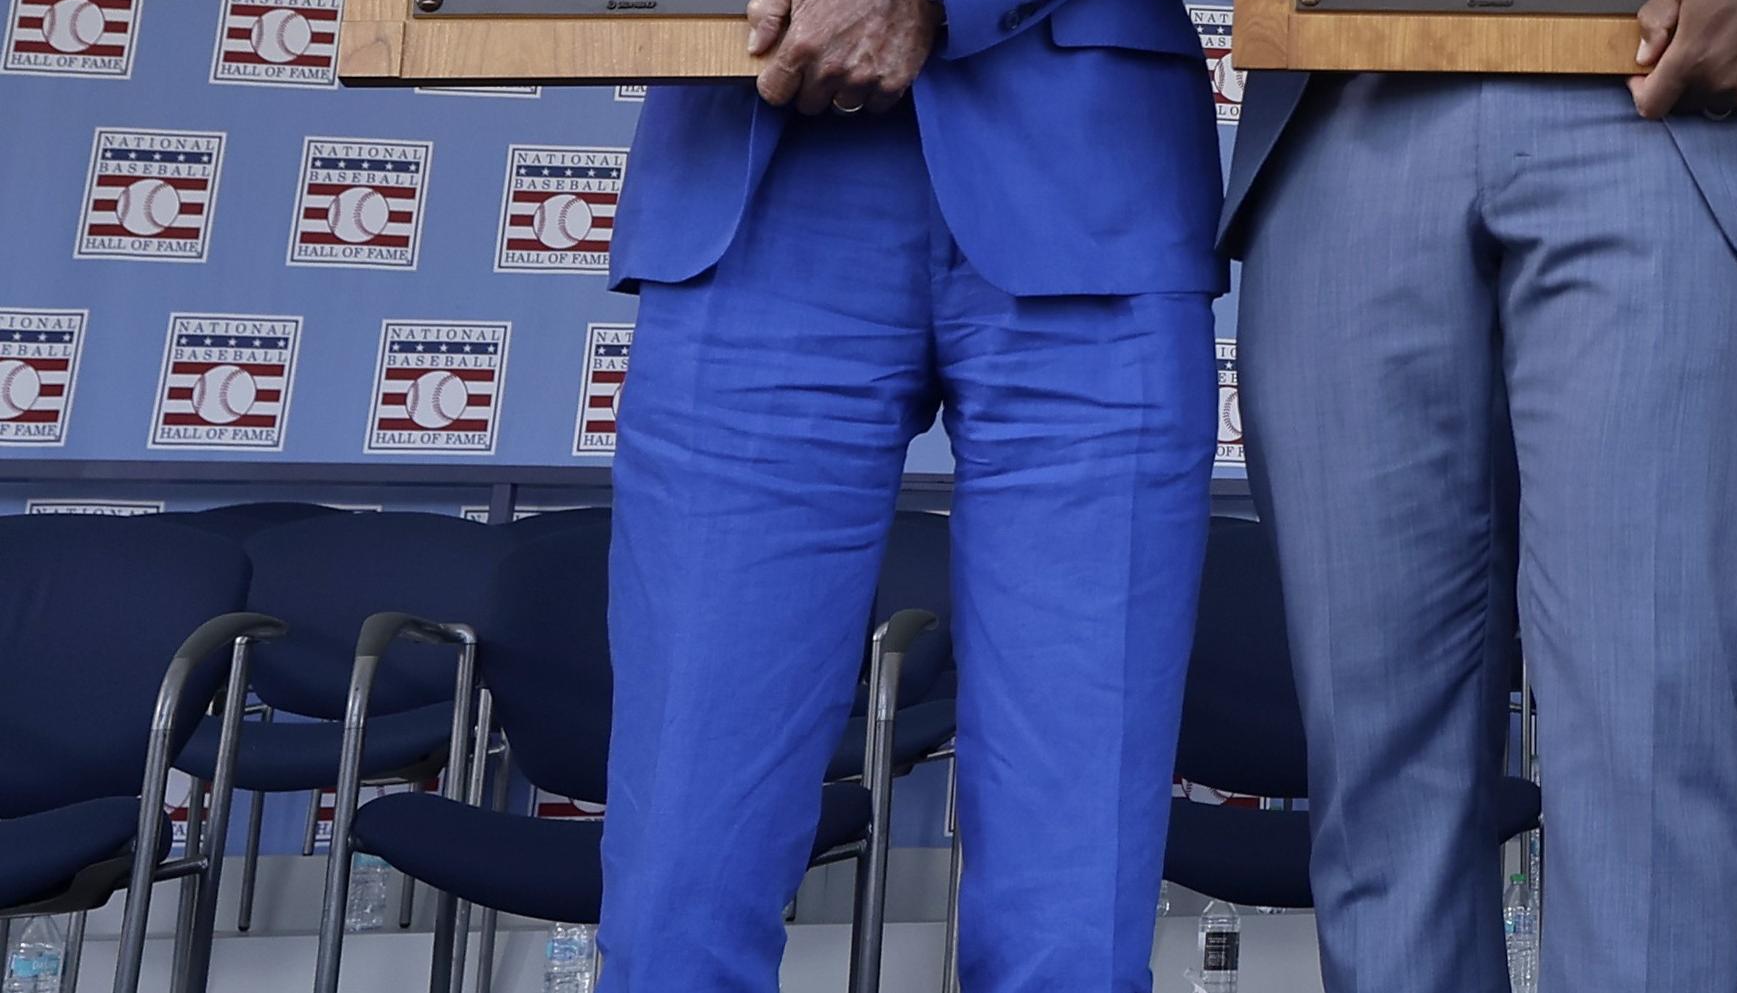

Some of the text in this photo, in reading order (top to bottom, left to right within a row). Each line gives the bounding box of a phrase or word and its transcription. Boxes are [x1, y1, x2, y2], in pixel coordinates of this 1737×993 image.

[11, 53, 127, 71] HALL OF FAME
[220, 64, 331, 81] HALL OF FAME
[103, 136, 213, 152] NATIONAL
[312, 145, 421, 159] NATIONAL
[517, 152, 622, 165] NATIONAL
[98, 162, 209, 176] BASEBALL
[309, 170, 417, 185] BASEBALL
[514, 178, 619, 191] BASEBALL
[85, 237, 199, 254] HALL OF FAME
[297, 245, 412, 261] HALL OF FAME
[504, 252, 543, 263] HALL
[548, 253, 567, 263] OF
[178, 321, 290, 335] NATIONAL
[390, 328, 499, 340] NATIONAL
[174, 348, 286, 362] BASEBALL
[387, 355, 496, 367] BASEBALL
[14, 424, 58, 437] FAME
[159, 427, 276, 442] HALL OF FAME
[375, 432, 488, 446] HALL OF FAME
